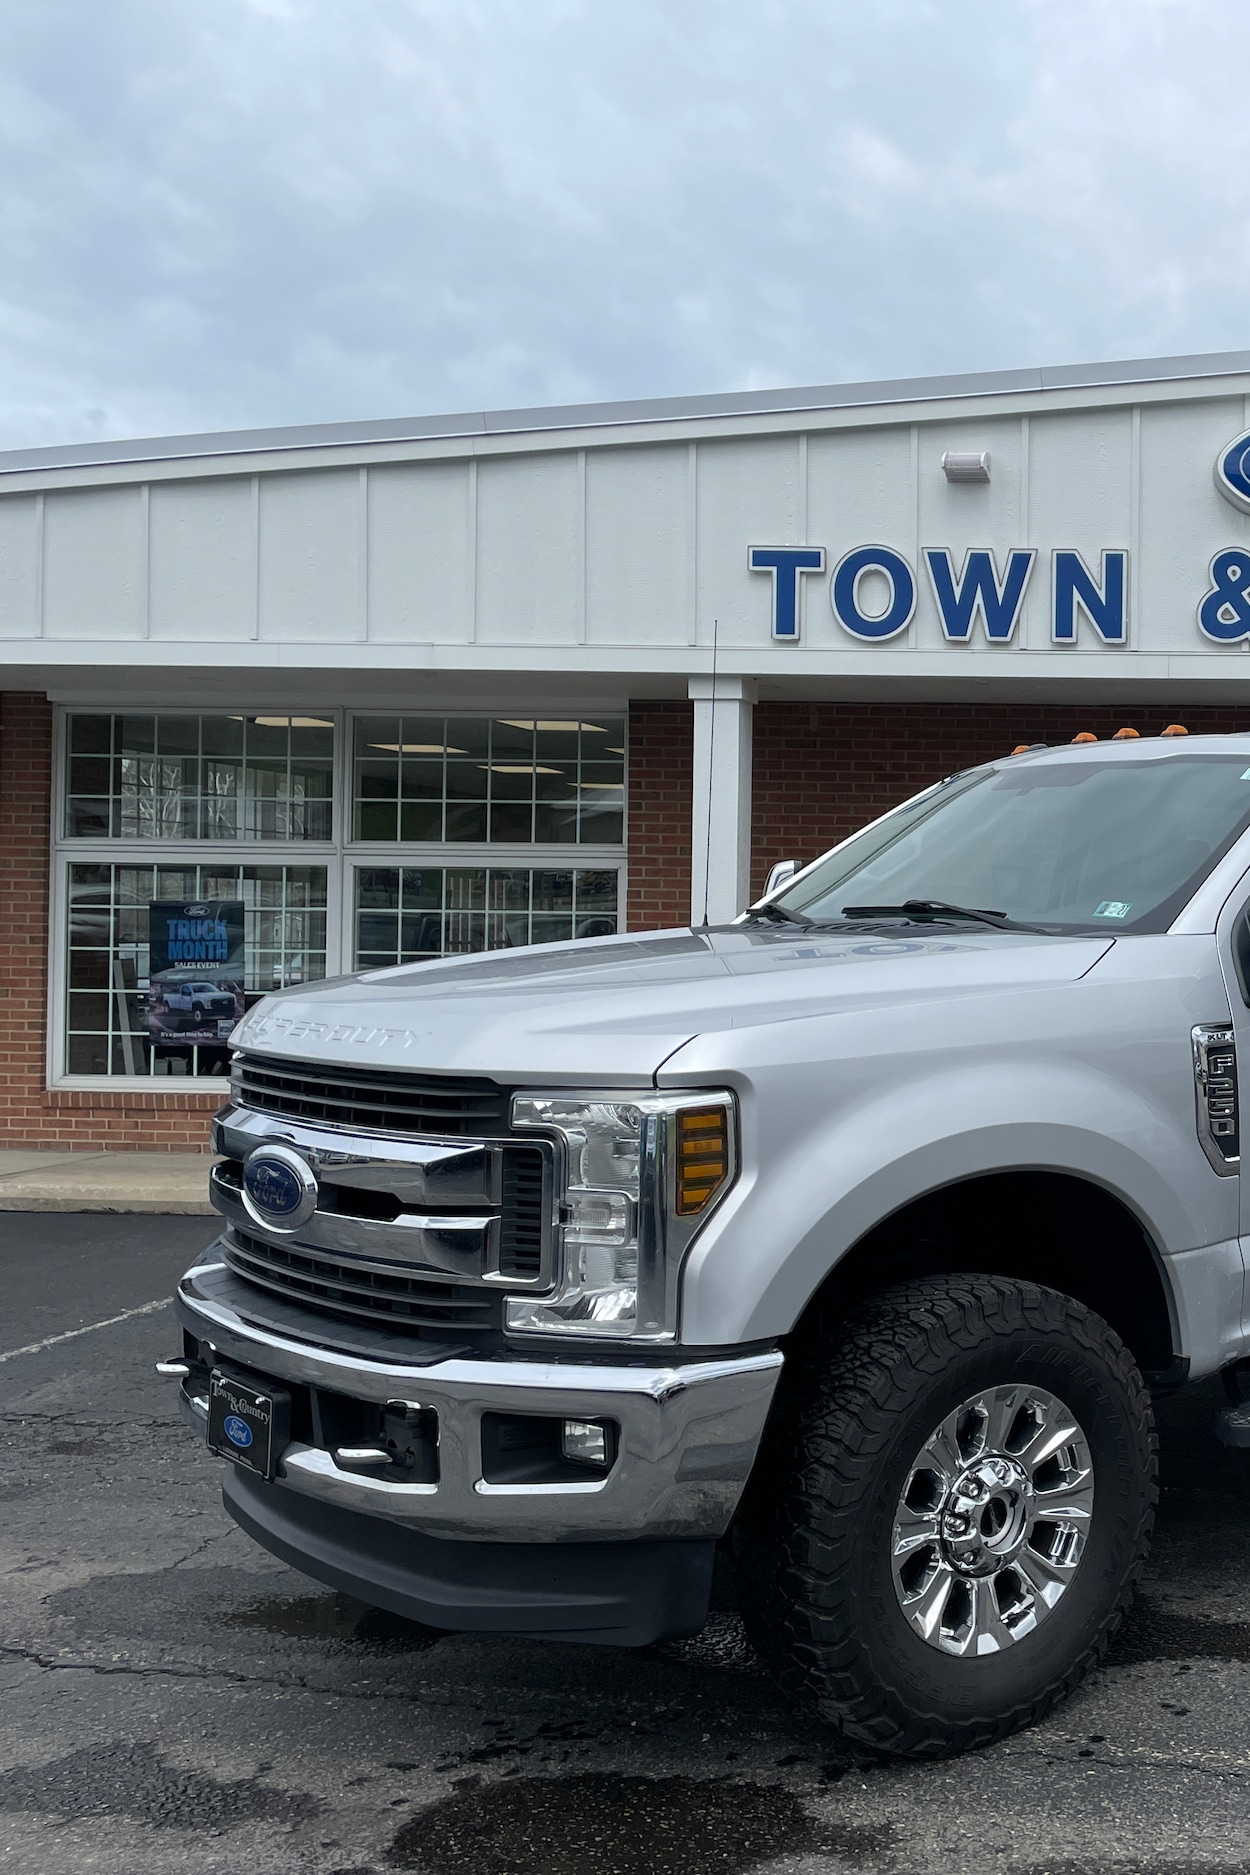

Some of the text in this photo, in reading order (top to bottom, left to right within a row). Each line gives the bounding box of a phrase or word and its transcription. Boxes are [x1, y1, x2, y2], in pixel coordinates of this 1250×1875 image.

[748, 544, 1128, 644] TOWN
[167, 919, 228, 940] TRUCK
[168, 940, 228, 960] MONTH
[174, 961, 220, 969] SALES EVENT
[253, 1165, 287, 1207] Ford
[211, 1378, 234, 1404] Town
[230, 1398, 241, 1414] &
[228, 1418, 249, 1443] Ford
